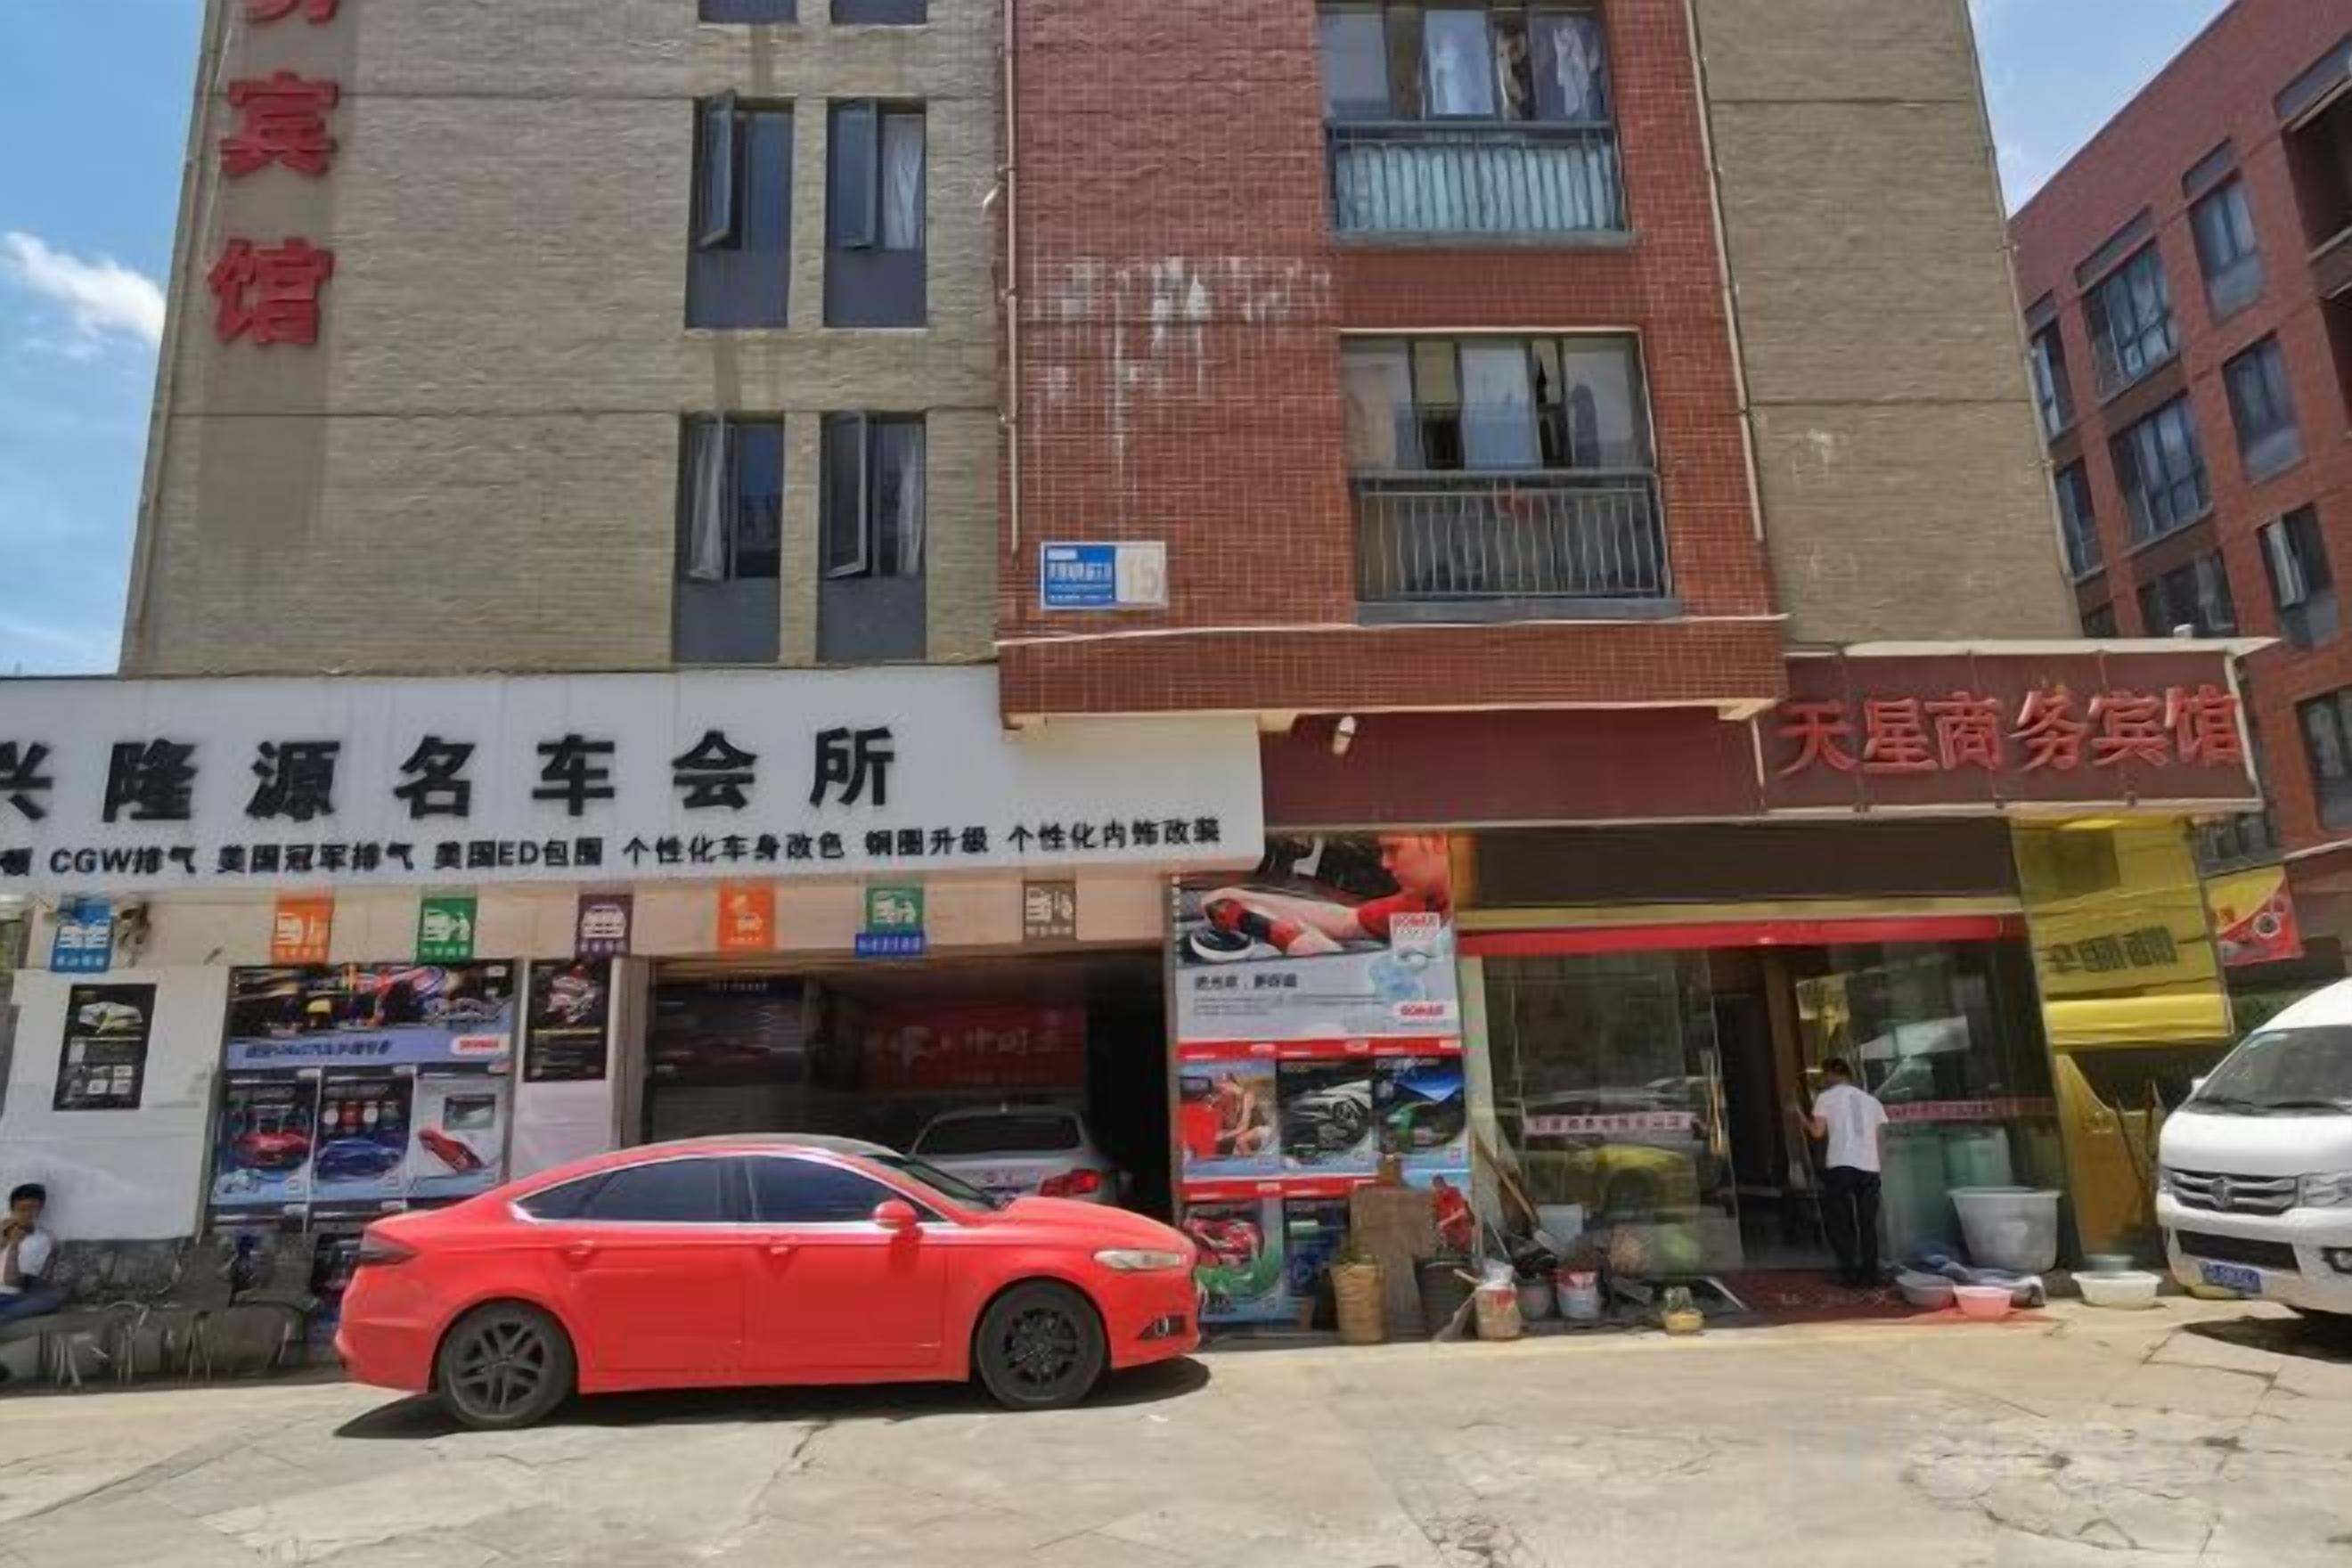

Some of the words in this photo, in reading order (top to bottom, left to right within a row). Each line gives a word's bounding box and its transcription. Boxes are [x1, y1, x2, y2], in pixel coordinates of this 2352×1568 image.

[208, 0, 339, 346] 宾馆
[0, 726, 894, 823] 兴隆源名车会所
[1780, 683, 2242, 775] 天星商务宾馆
[623, 829, 845, 868] 个性化车身改色
[1008, 816, 1221, 853] 个性化内饰改装
